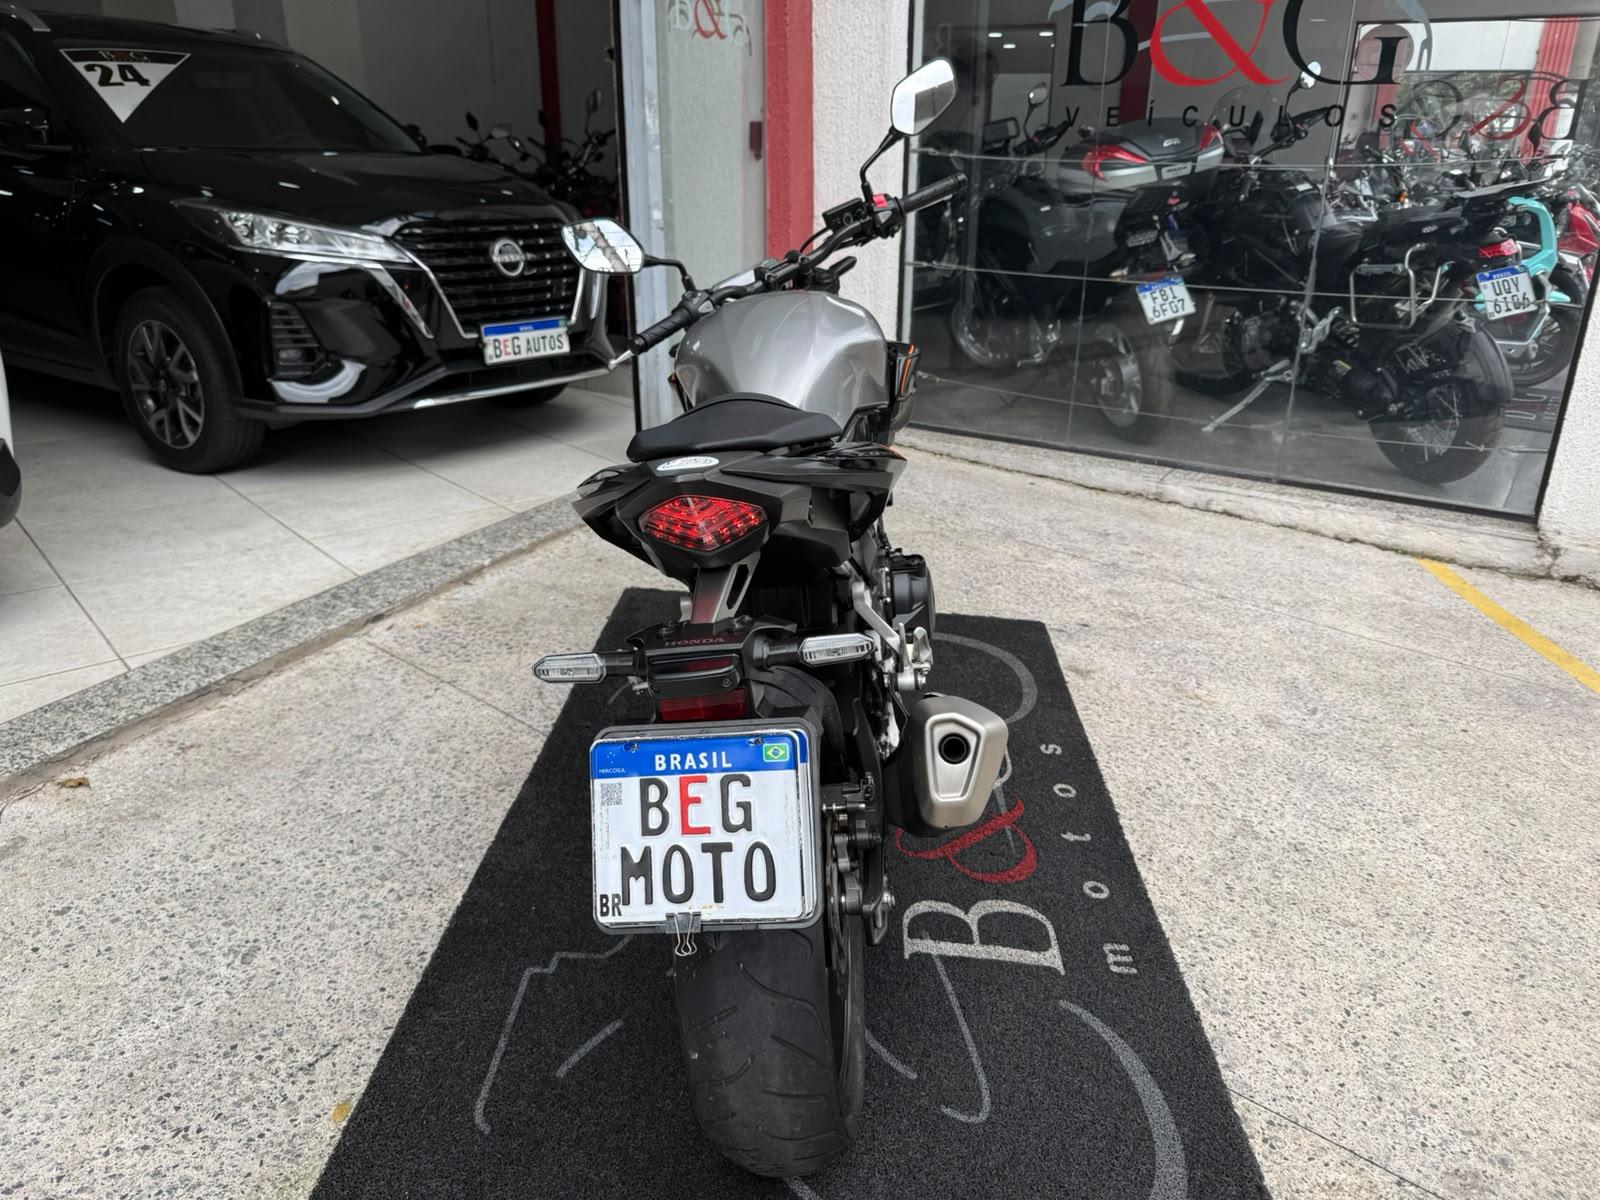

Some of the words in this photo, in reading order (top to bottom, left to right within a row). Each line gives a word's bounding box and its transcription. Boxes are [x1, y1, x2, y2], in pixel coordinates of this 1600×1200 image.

[83, 63, 152, 87] 24
[1065, 100, 1398, 128] VEÍCULOS
[1491, 276, 1520, 297] UQY
[493, 336, 522, 359] BEG
[526, 334, 564, 354] AUTOS
[664, 637, 725, 647] HONDA
[654, 751, 733, 772] BRASIL
[639, 773, 753, 837] BEG
[1039, 742, 1138, 975] motos
[620, 840, 777, 906] MOTO
[600, 893, 623, 917] BR
